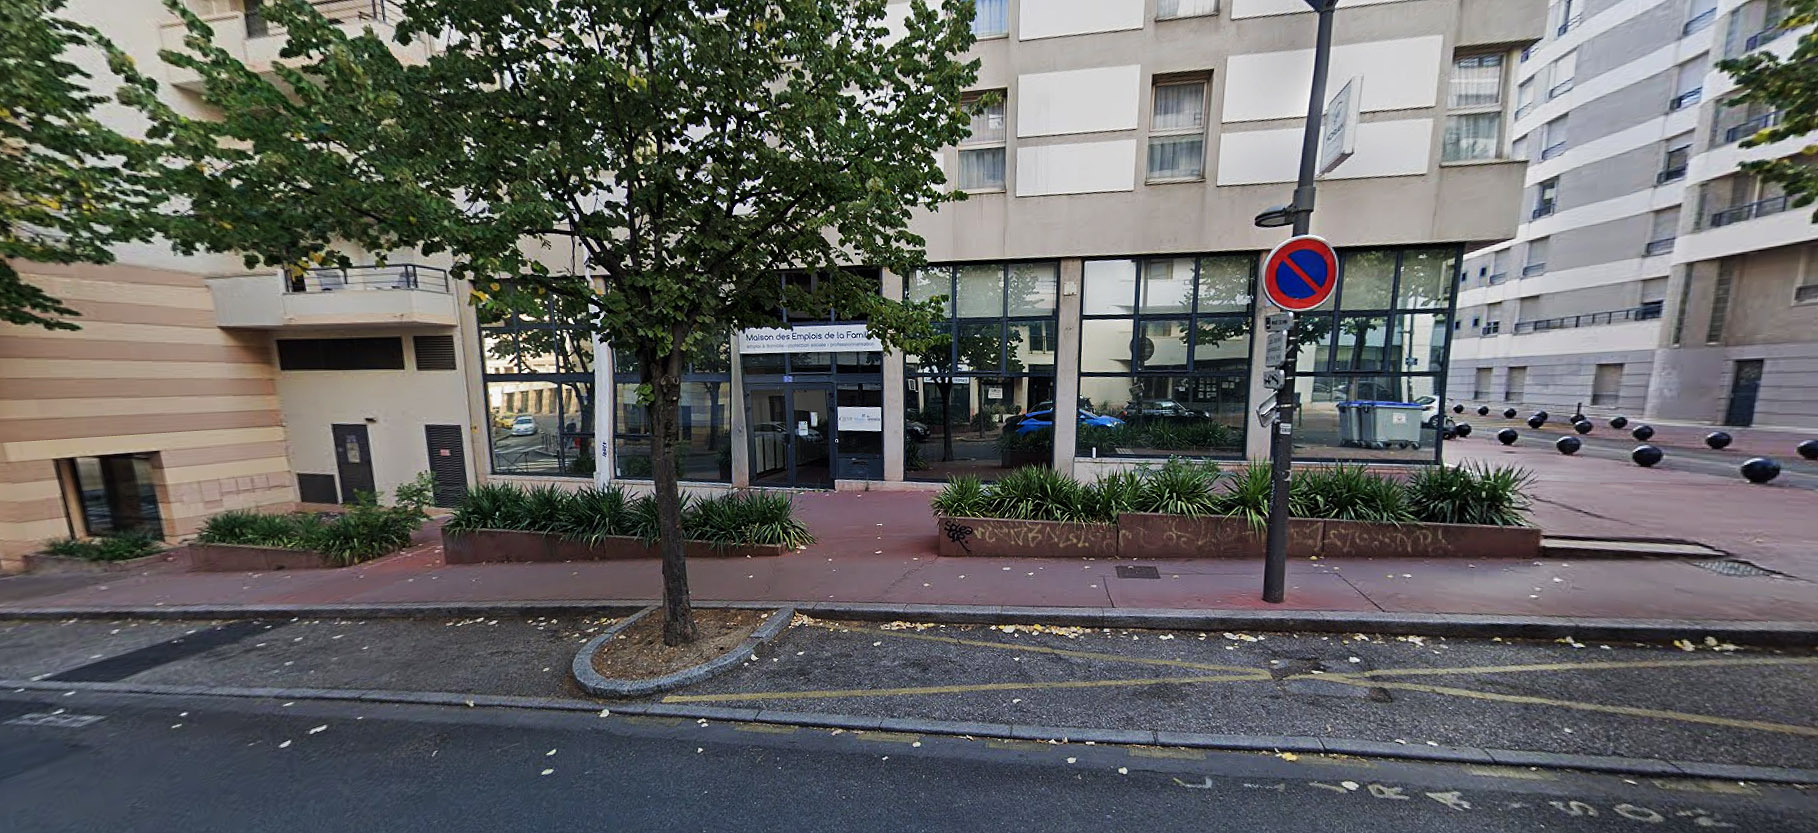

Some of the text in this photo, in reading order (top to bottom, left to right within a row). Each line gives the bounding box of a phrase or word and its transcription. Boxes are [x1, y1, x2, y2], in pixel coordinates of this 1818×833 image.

[745, 333, 774, 341] Maison
[775, 332, 791, 341] des
[791, 332, 823, 342] Emplois
[824, 331, 835, 340] de
[836, 331, 846, 340] la
